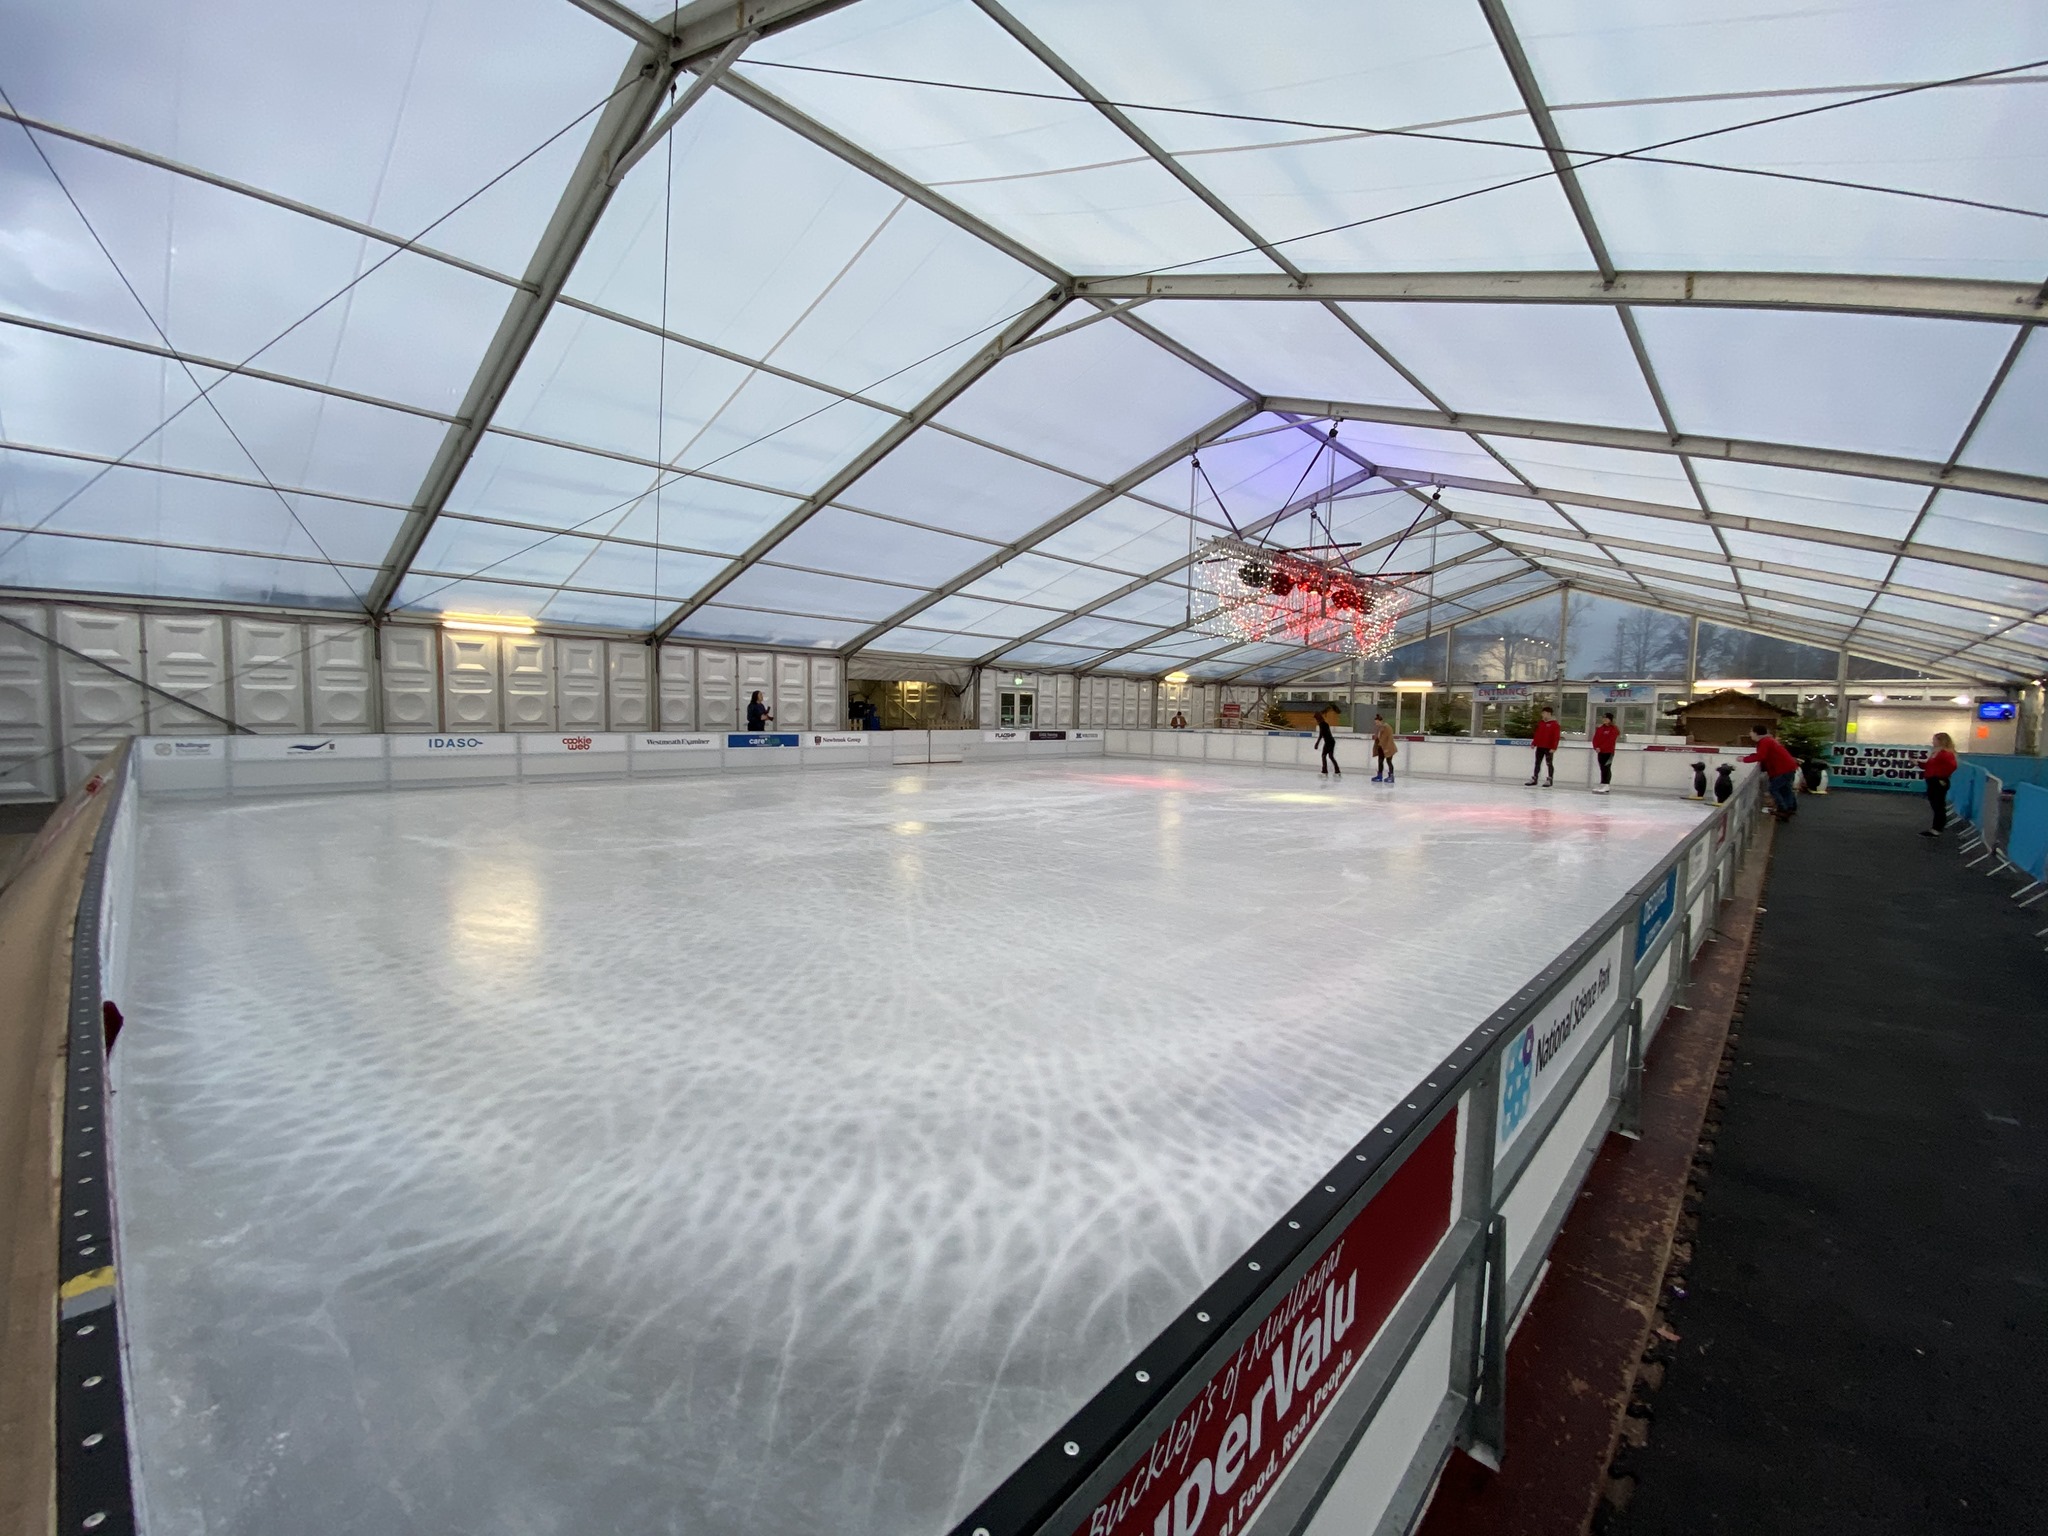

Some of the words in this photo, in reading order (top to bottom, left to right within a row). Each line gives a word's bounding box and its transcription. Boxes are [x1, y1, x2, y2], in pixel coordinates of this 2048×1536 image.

[1478, 686, 1529, 697] ENTRANCE
[1609, 688, 1634, 698] EXIT
[428, 738, 483, 748] IDASO
[562, 736, 592, 745] cookie
[1833, 746, 1858, 756] NO
[1864, 748, 1928, 760] SKATES
[1843, 756, 1914, 769] BEYOND
[1832, 766, 1866, 776] THIS
[1872, 768, 1926, 780] POINT
[1535, 1000, 1574, 1078] National
[1573, 981, 1598, 1031] Science
[1597, 957, 1611, 999] Park
[1089, 1380, 1217, 1536] Buckley's
[1222, 1342, 1248, 1421] of
[1247, 1239, 1345, 1371] Mullingar
[1282, 1402, 1311, 1459] Real
[1313, 1348, 1353, 1413] People
